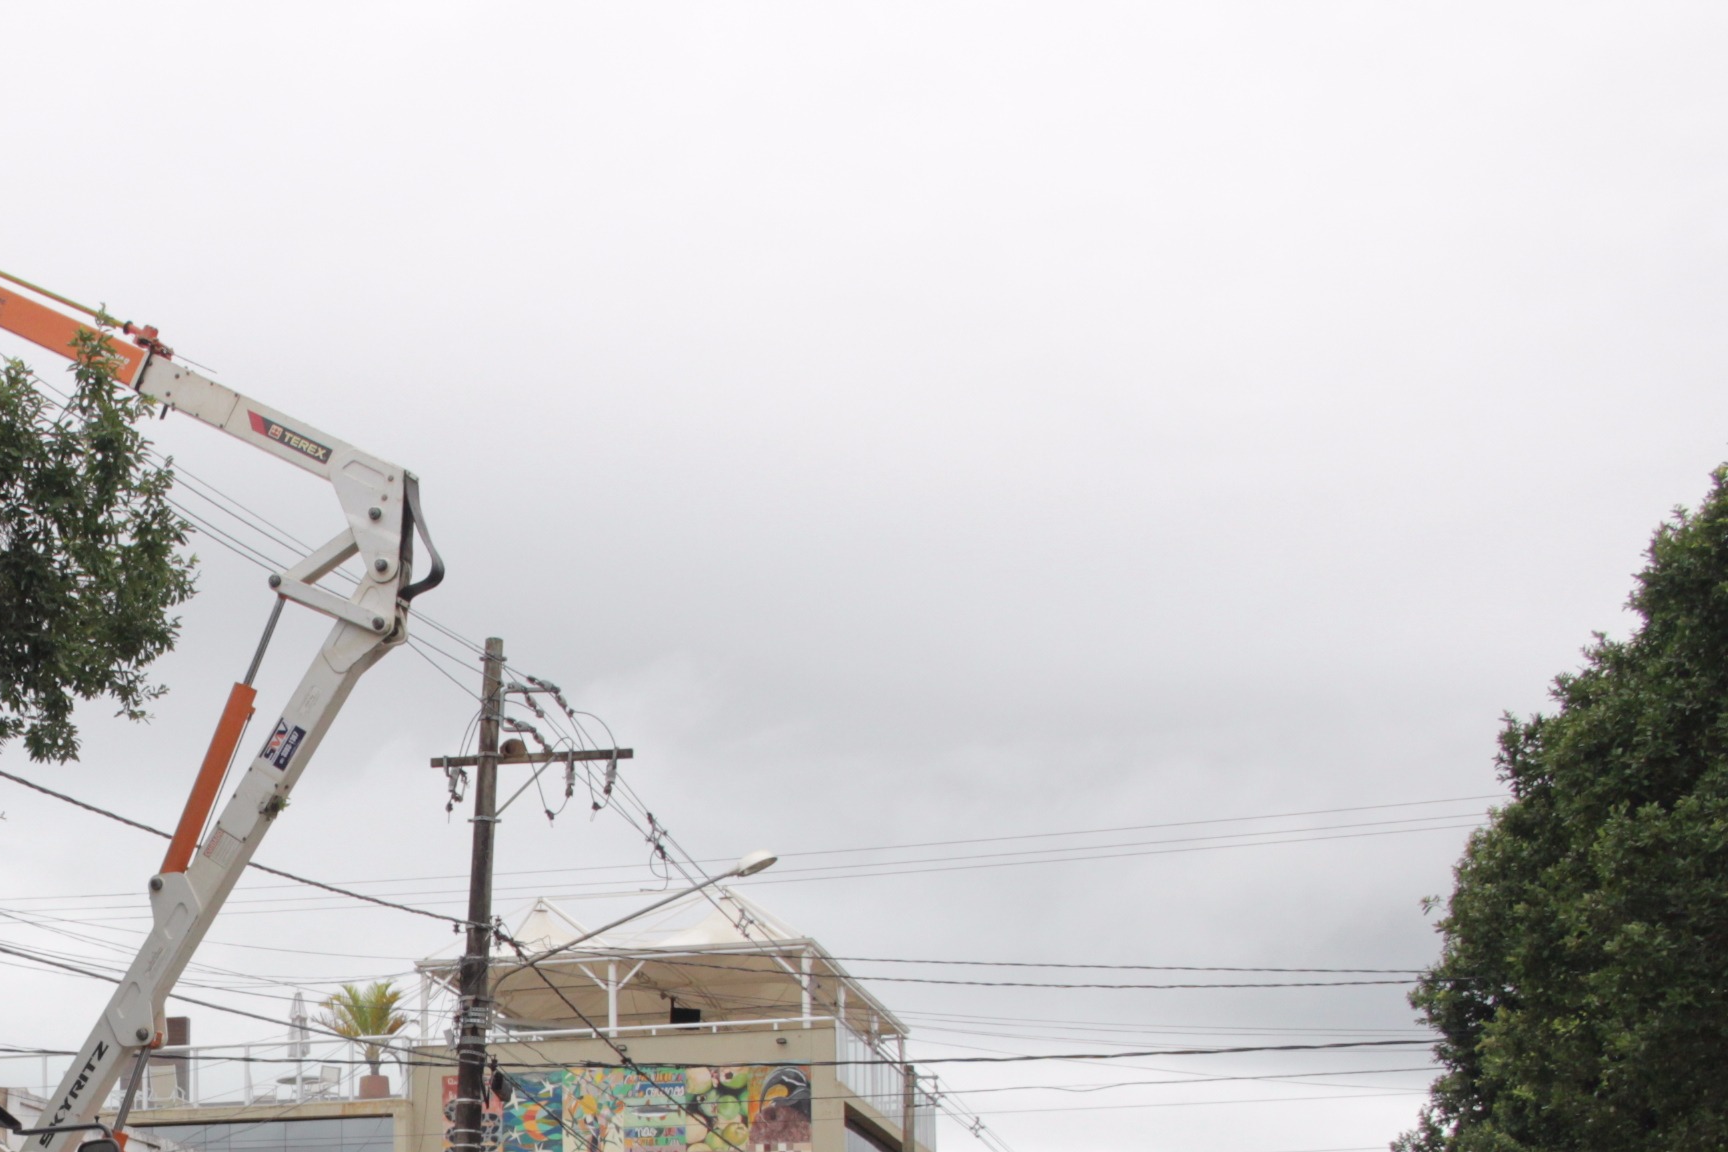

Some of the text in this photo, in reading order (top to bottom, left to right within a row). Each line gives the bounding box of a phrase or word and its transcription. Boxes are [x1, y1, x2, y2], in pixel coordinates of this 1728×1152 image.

[284, 431, 327, 460] TEREX
[264, 721, 289, 761] SMV
[39, 1040, 109, 1149] SKYRITZ
